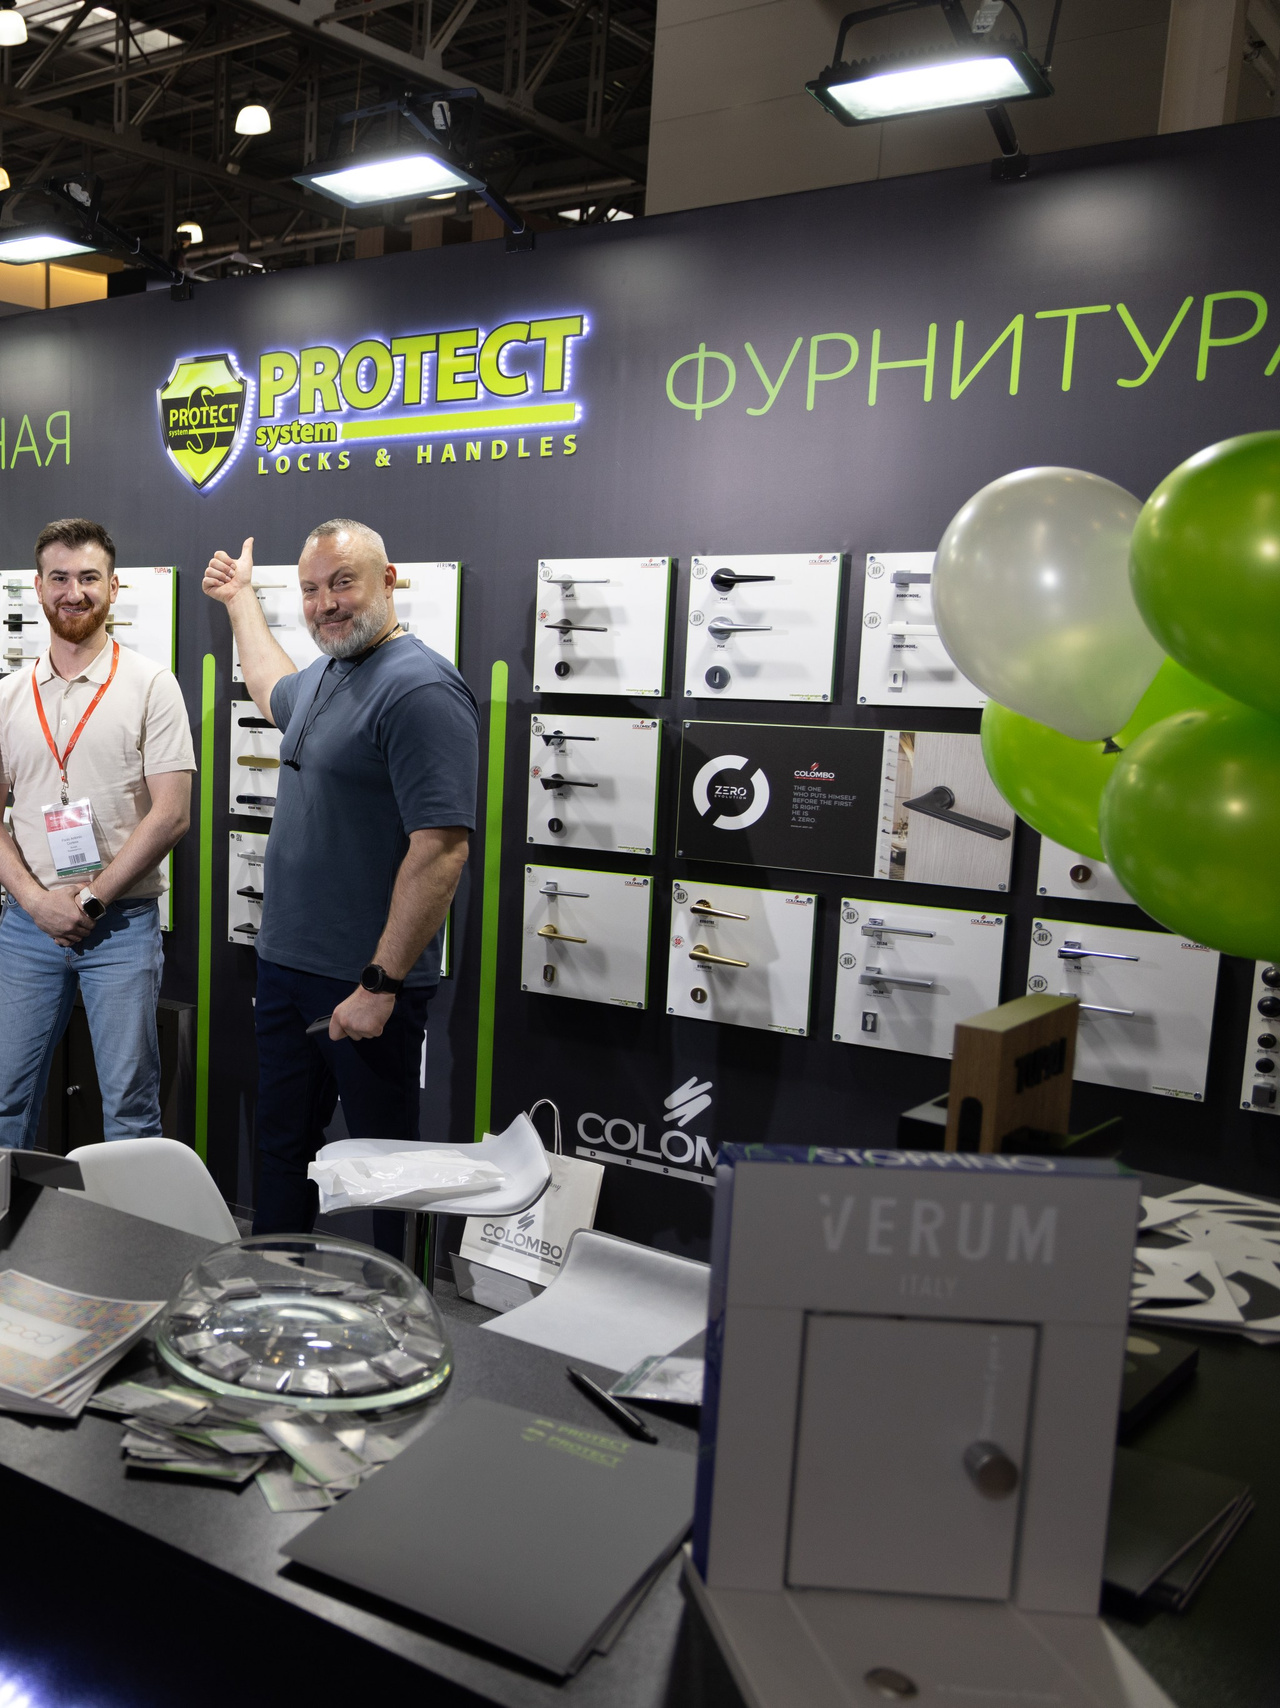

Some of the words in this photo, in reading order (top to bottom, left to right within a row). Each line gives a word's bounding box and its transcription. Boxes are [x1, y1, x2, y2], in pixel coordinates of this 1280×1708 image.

[258, 315, 584, 419] PROTECT
[665, 290, 1280, 421] ФУРНИТУР
[169, 403, 239, 427] PROTECT
[168, 428, 189, 438] system
[255, 420, 338, 452] system
[258, 451, 351, 475] LOCKS
[374, 448, 391, 468] &
[417, 434, 578, 464] HANDLES
[794, 770, 835, 778] COLOMBO
[715, 786, 747, 796] ZERO
[483, 1223, 563, 1260] COLOMBO
[822, 1196, 1058, 1265] VERUM
[900, 1276, 959, 1298] ITALY
